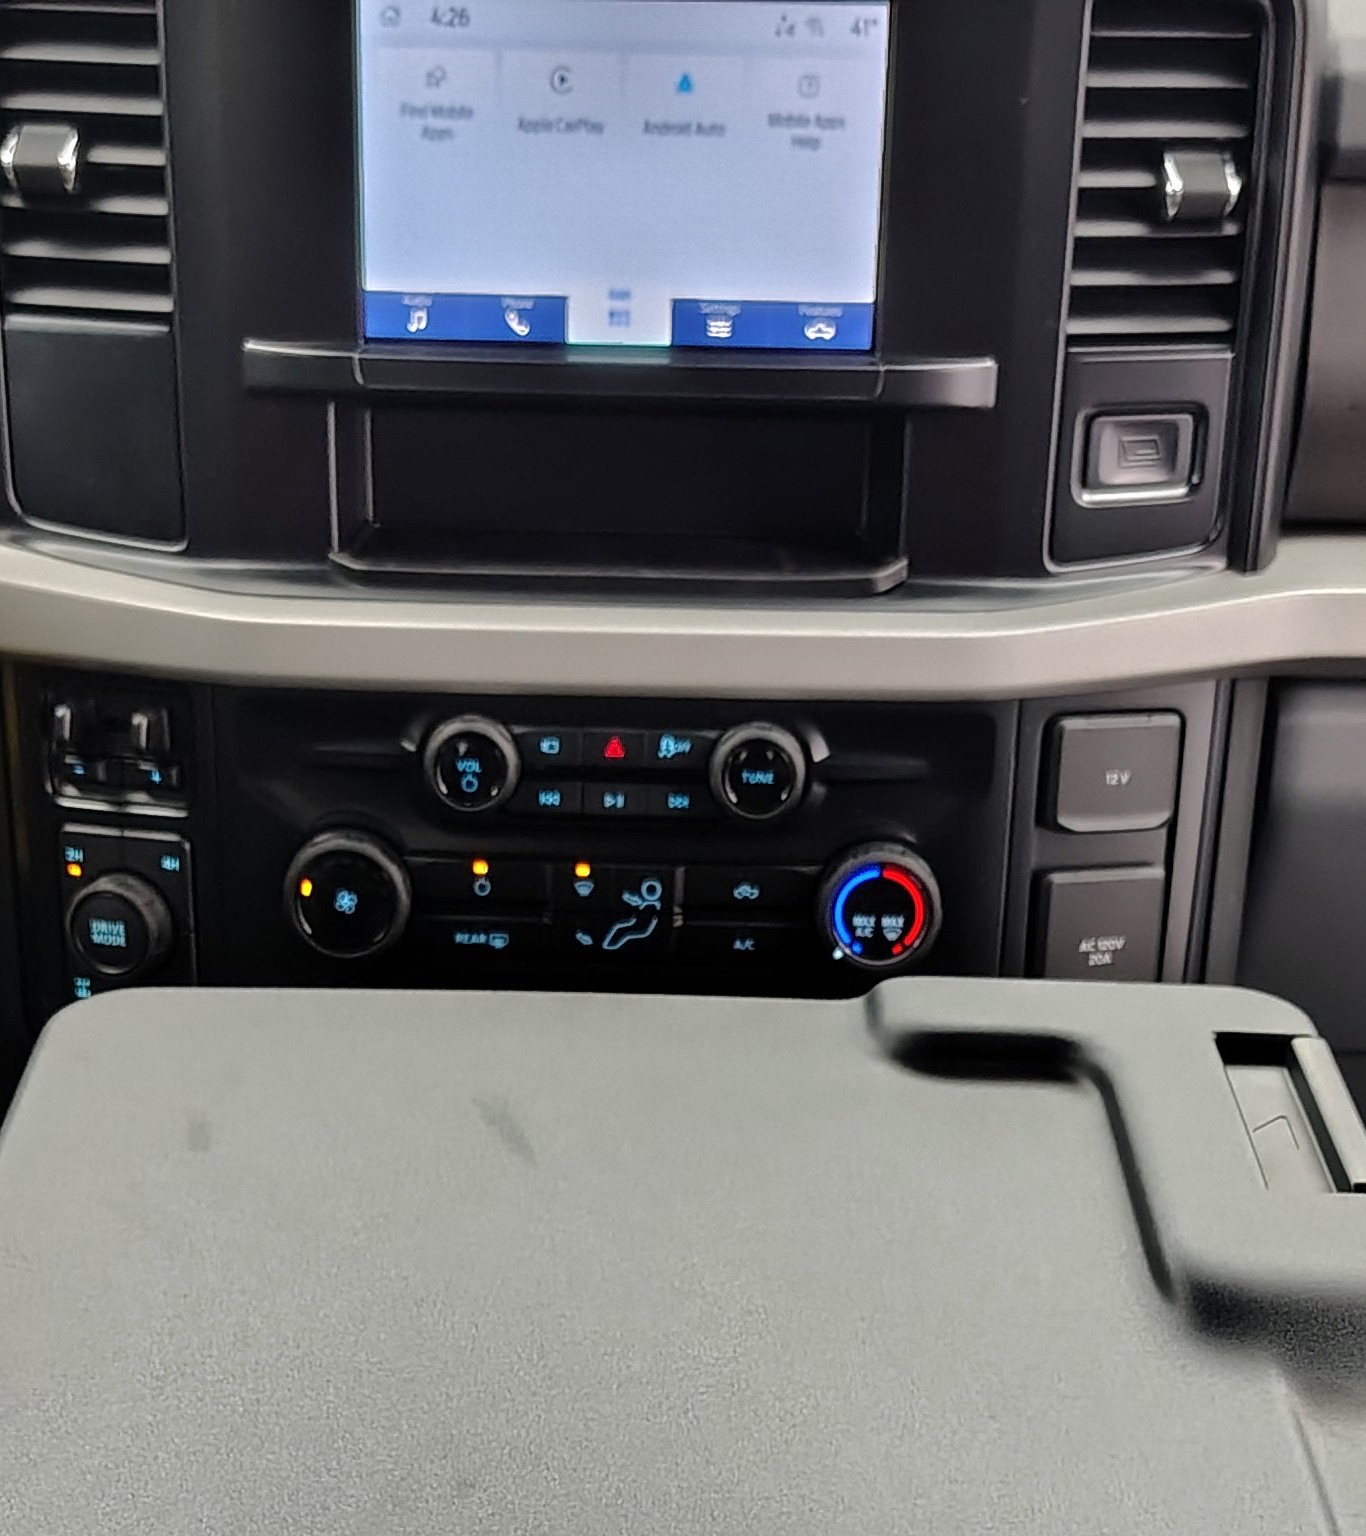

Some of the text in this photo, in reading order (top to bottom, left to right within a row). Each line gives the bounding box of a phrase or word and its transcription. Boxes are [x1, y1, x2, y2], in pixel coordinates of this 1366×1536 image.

[455, 758, 483, 776] VOL
[88, 919, 126, 935] DRIVE
[90, 933, 127, 949] MODE
